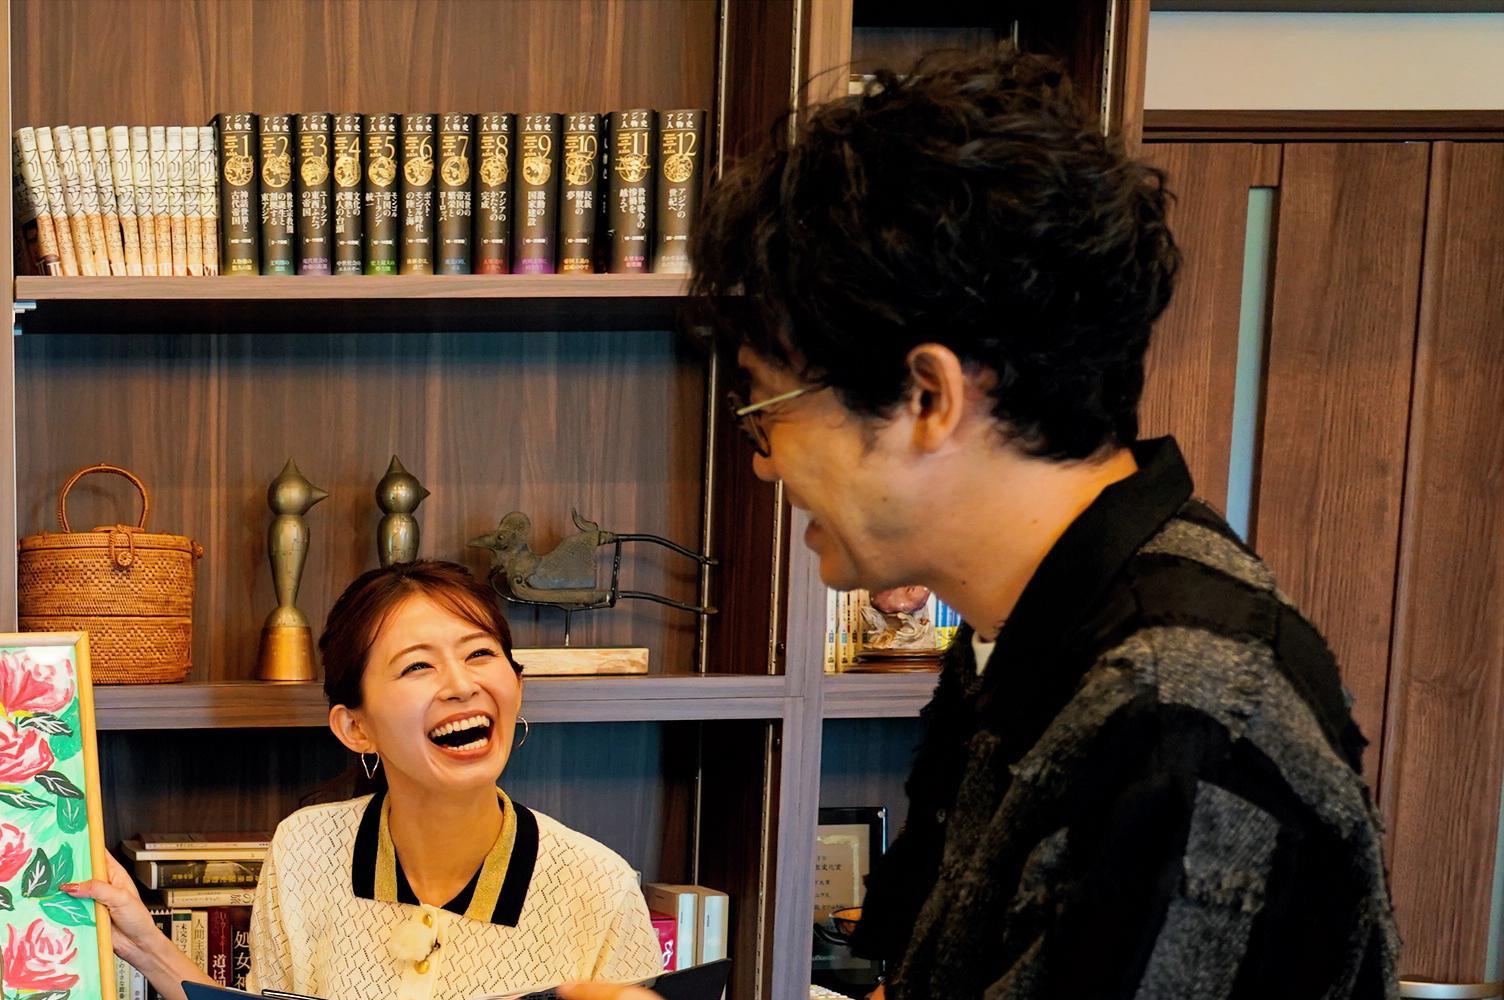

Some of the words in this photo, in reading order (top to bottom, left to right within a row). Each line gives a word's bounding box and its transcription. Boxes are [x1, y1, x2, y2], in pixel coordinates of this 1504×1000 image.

[241, 136, 249, 158] 1
[277, 136, 288, 155] 2
[317, 135, 327, 159] 3
[348, 137, 360, 161] 4
[384, 136, 395, 159] 5
[420, 136, 433, 159] 6
[457, 136, 468, 158] 7
[496, 135, 508, 159] 8
[538, 135, 552, 158] 9
[578, 136, 597, 159] 10
[632, 132, 648, 155] 11
[677, 132, 696, 156] 12
[231, 192, 240, 225] 古代帝国
[302, 192, 311, 217] の帝国
[312, 192, 320, 229] 東西ふたつ
